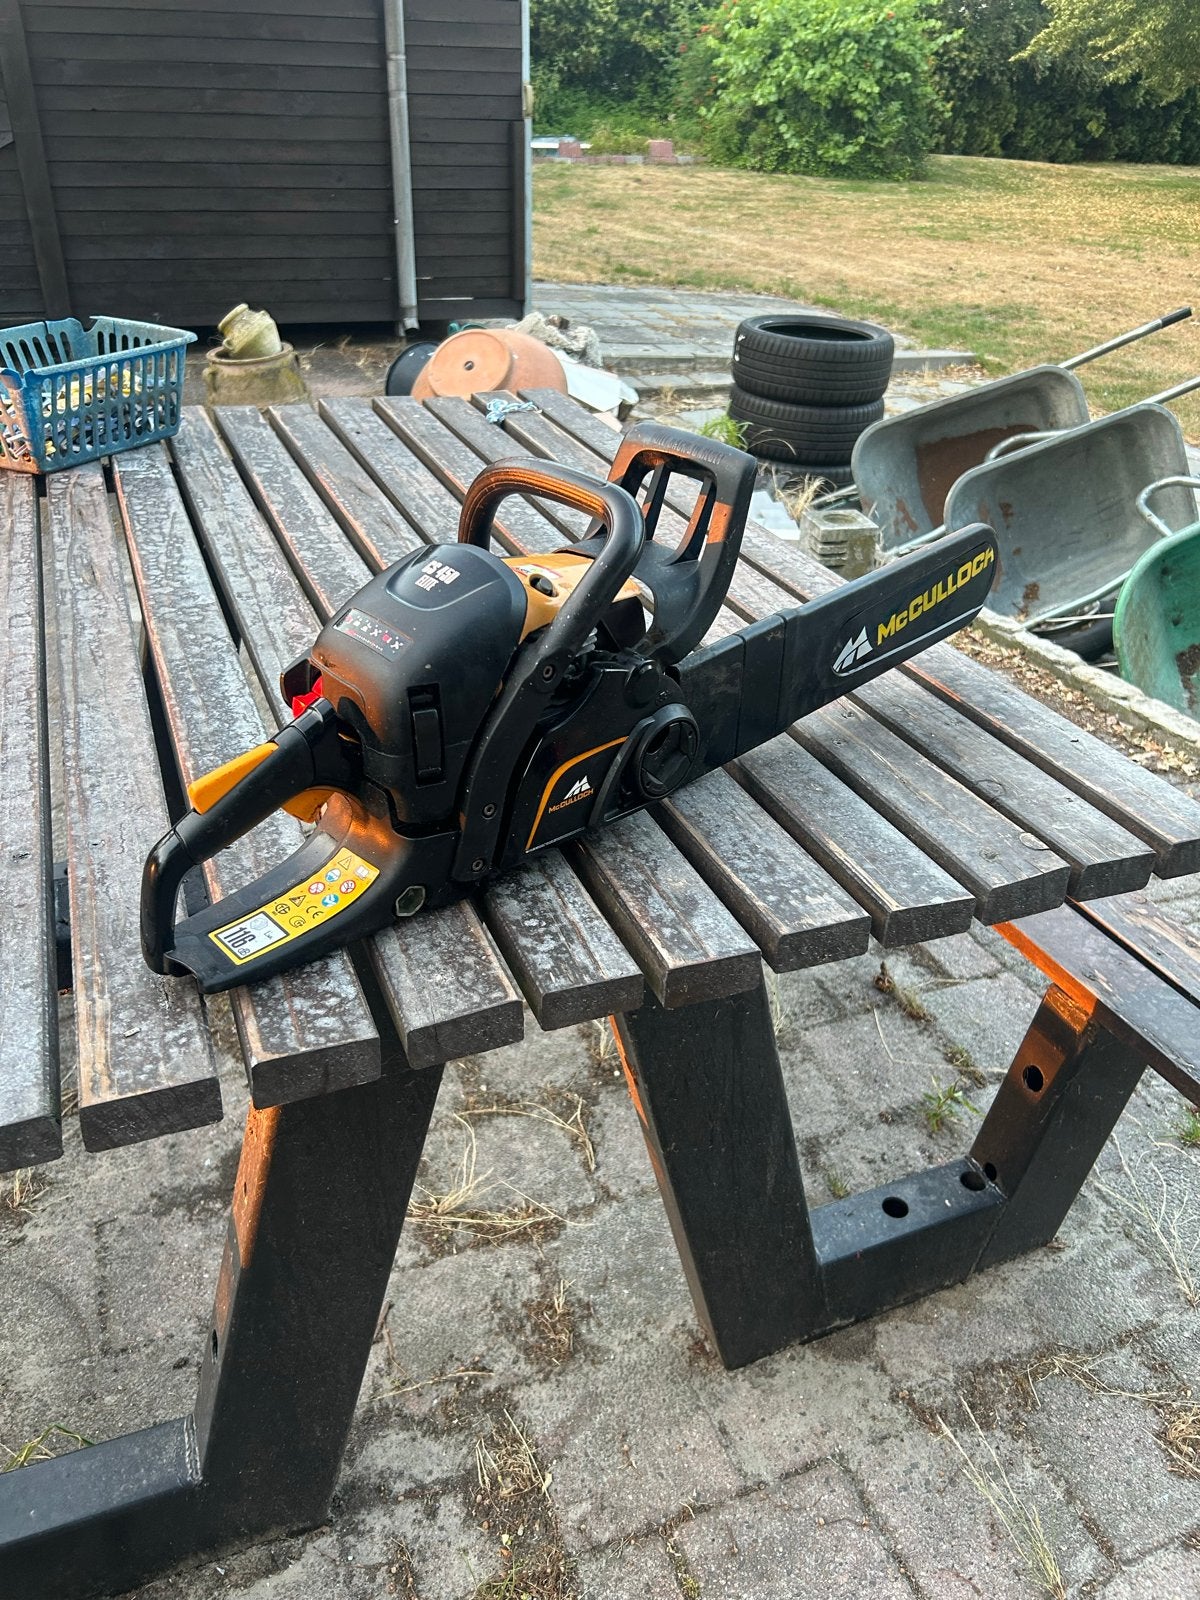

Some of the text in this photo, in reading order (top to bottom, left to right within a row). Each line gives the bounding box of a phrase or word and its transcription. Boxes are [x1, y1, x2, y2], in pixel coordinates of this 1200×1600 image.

[414, 574, 440, 592] ELITE
[435, 565, 461, 585] 450
[877, 547, 995, 646] McCULLOCH
[548, 788, 594, 814] McCULLOCH
[223, 926, 257, 949] 116
